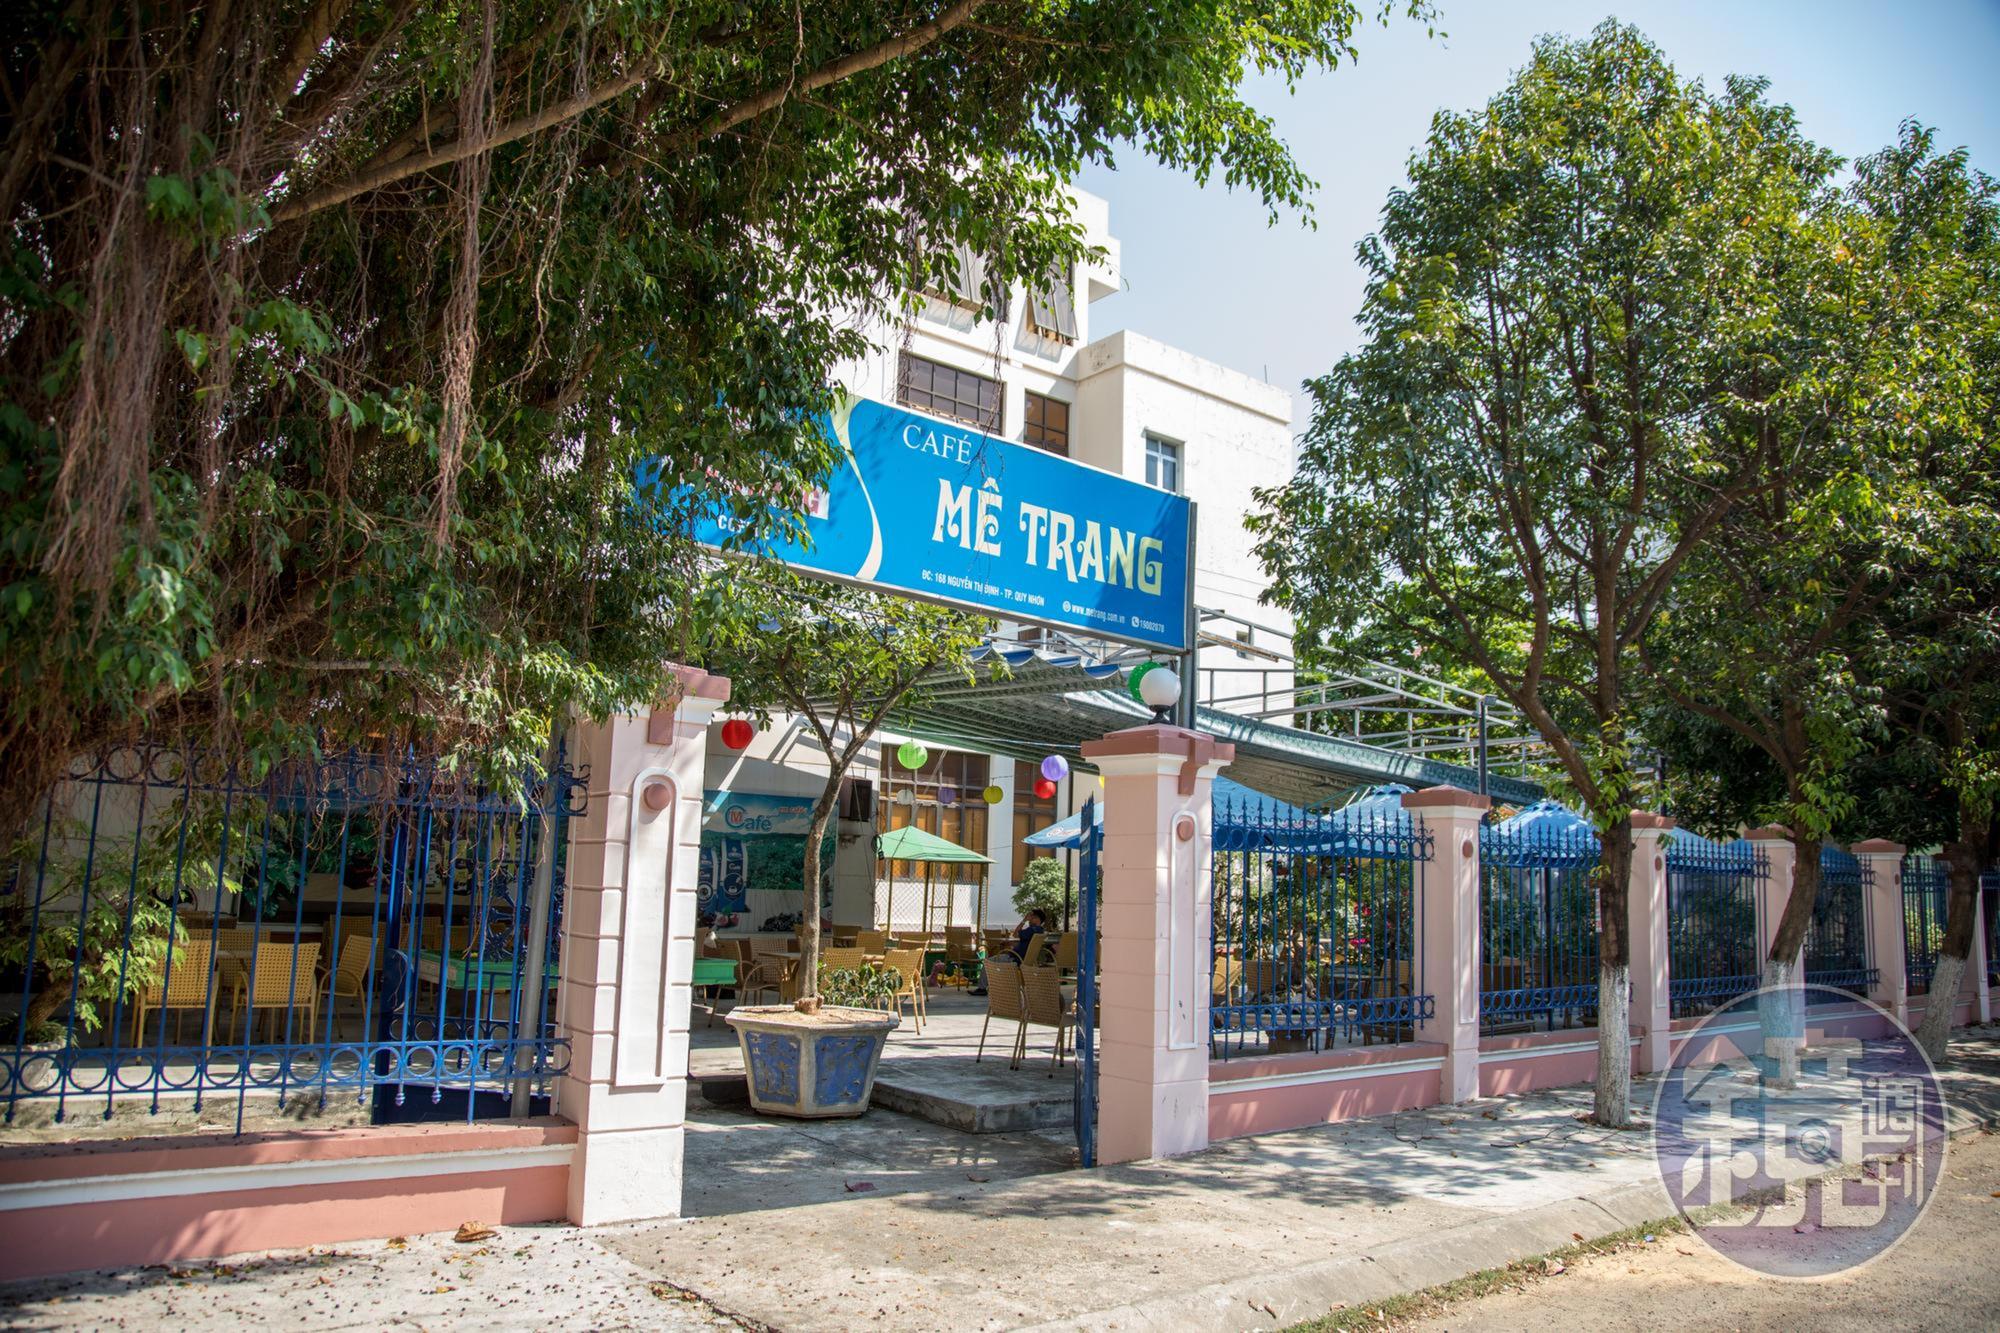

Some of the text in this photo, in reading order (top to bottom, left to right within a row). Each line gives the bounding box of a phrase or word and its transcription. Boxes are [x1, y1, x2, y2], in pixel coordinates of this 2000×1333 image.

[903, 424, 972, 465] CAFÉ
[932, 477, 1164, 597] MÊ TRANG
[1014, 591, 1028, 603] QUY
